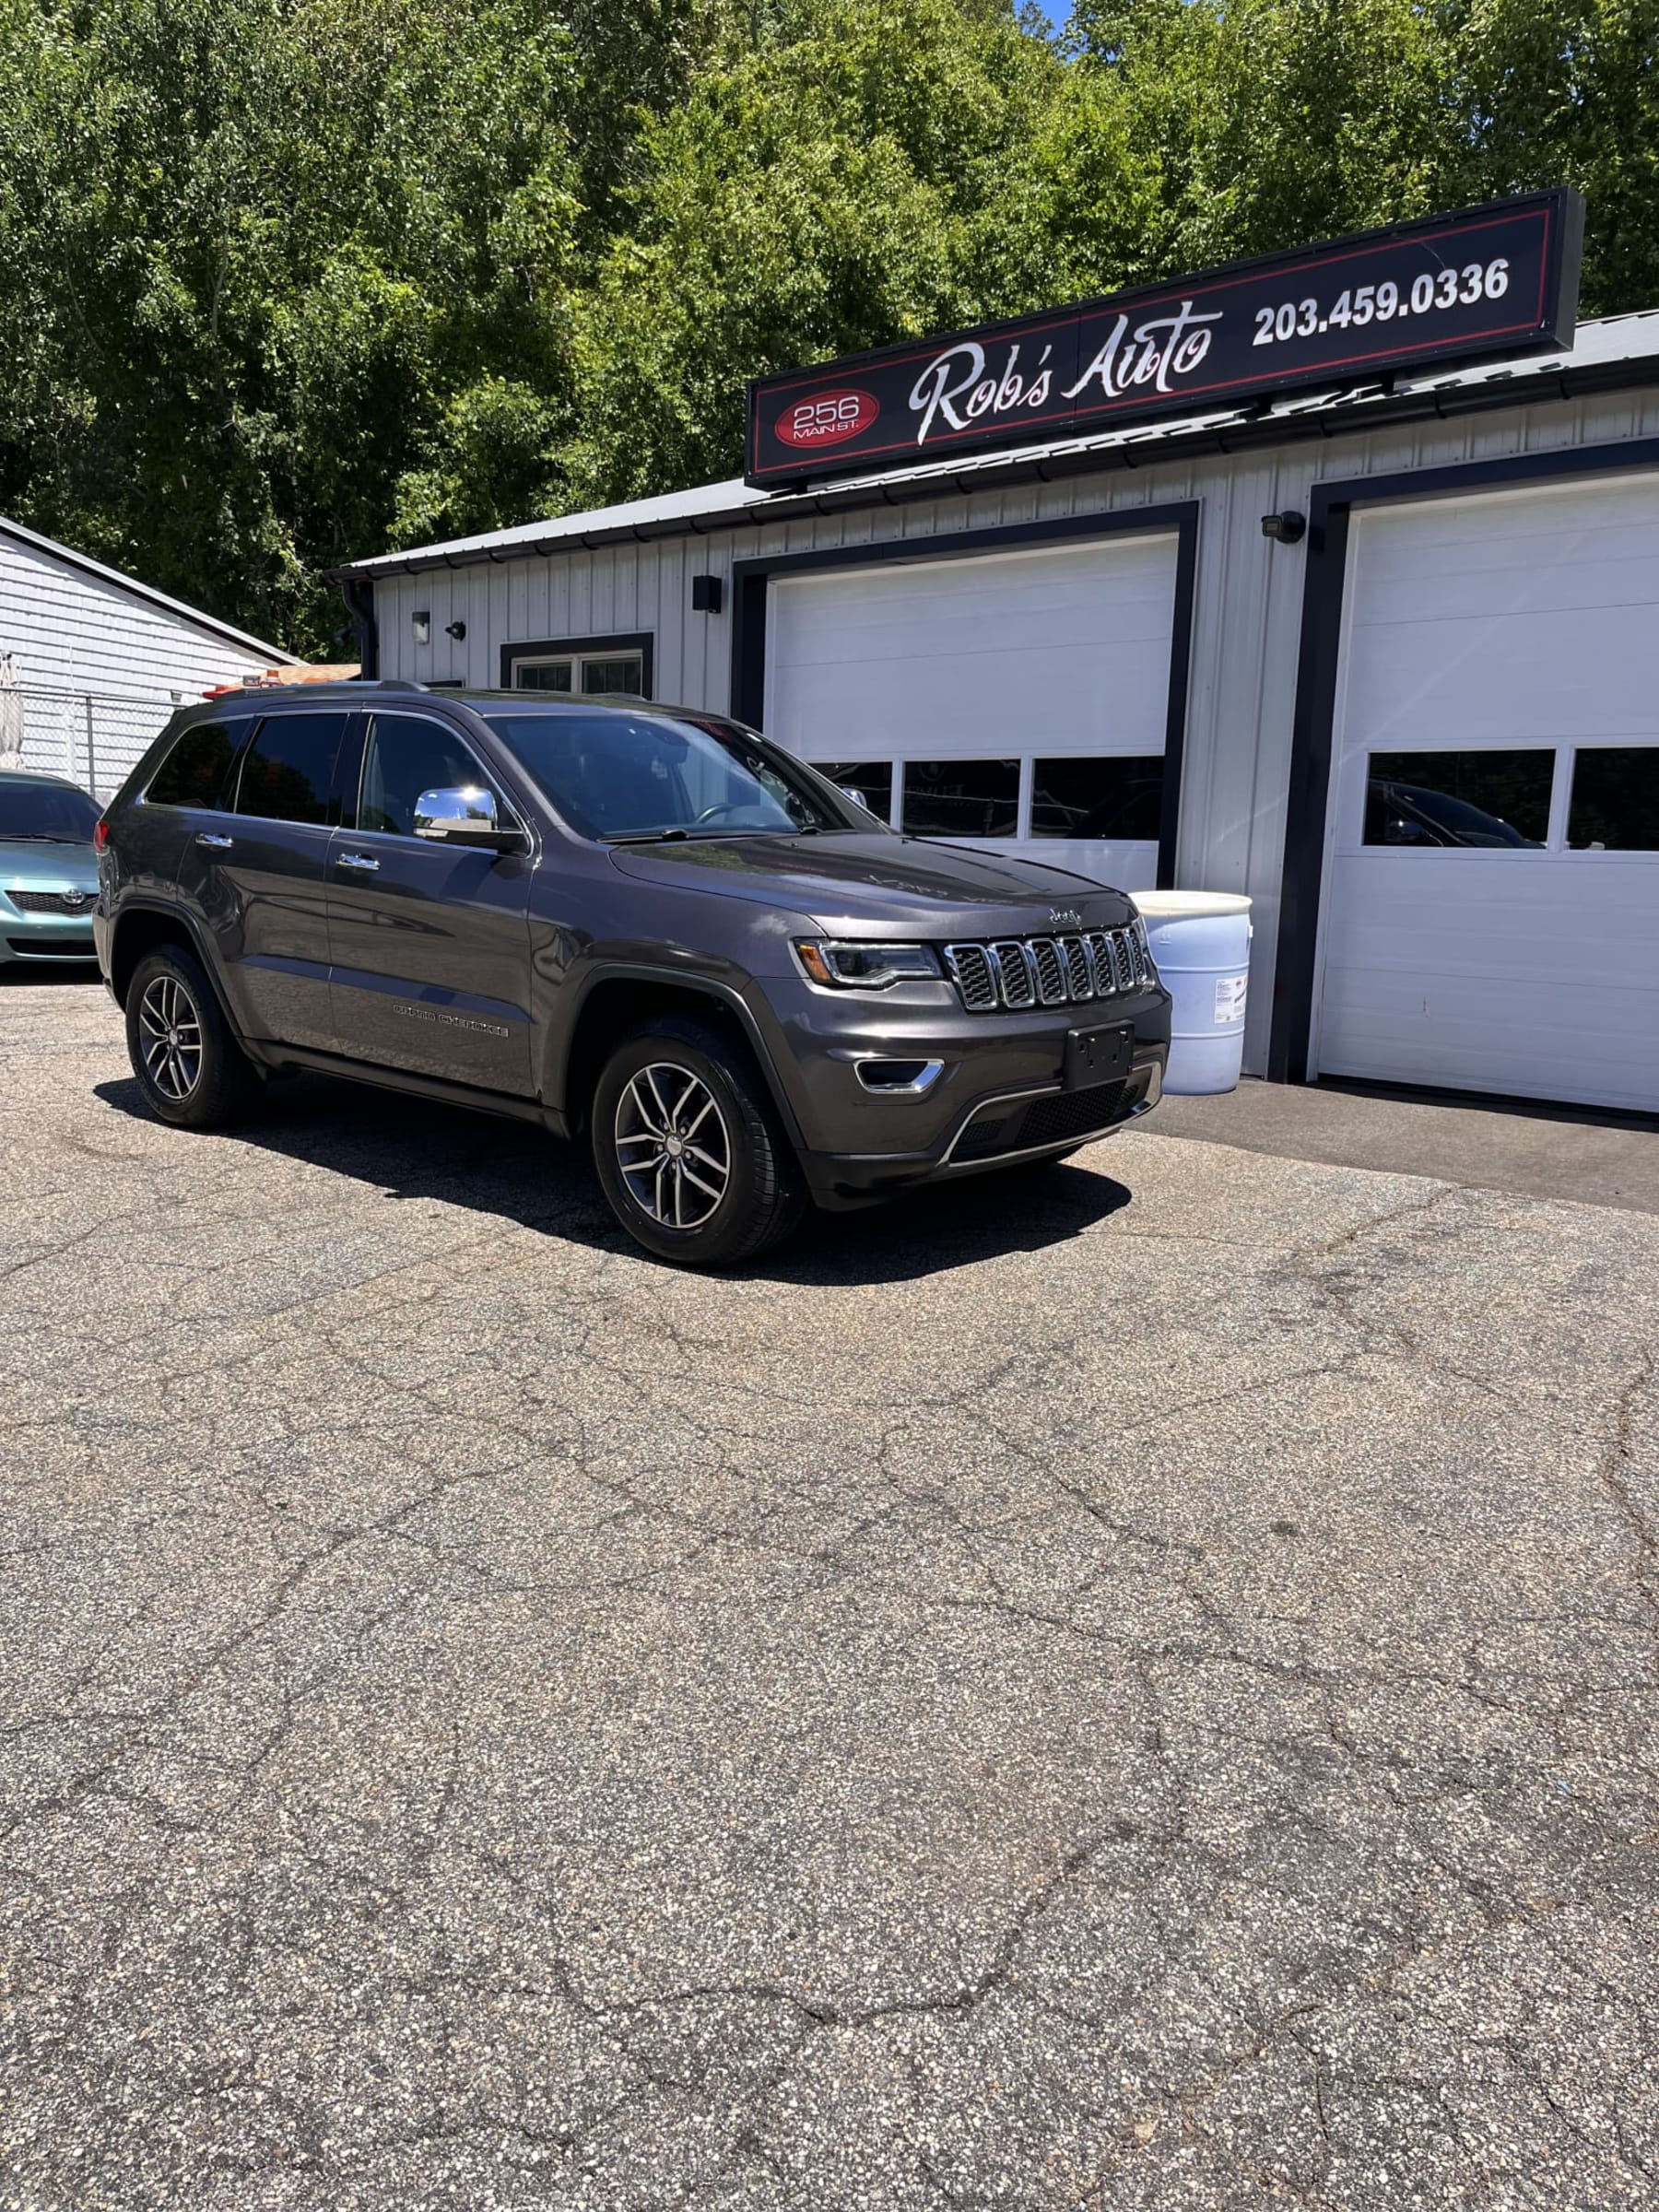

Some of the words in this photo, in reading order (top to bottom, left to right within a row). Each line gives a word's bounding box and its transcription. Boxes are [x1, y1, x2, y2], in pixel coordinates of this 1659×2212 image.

[1253, 257, 1510, 347] 203.459.0336
[908, 342, 1053, 446] Rob's
[1061, 300, 1224, 399] Auto
[793, 395, 860, 429] 256
[793, 424, 835, 440] MAIN
[836, 419, 860, 431] ST.
